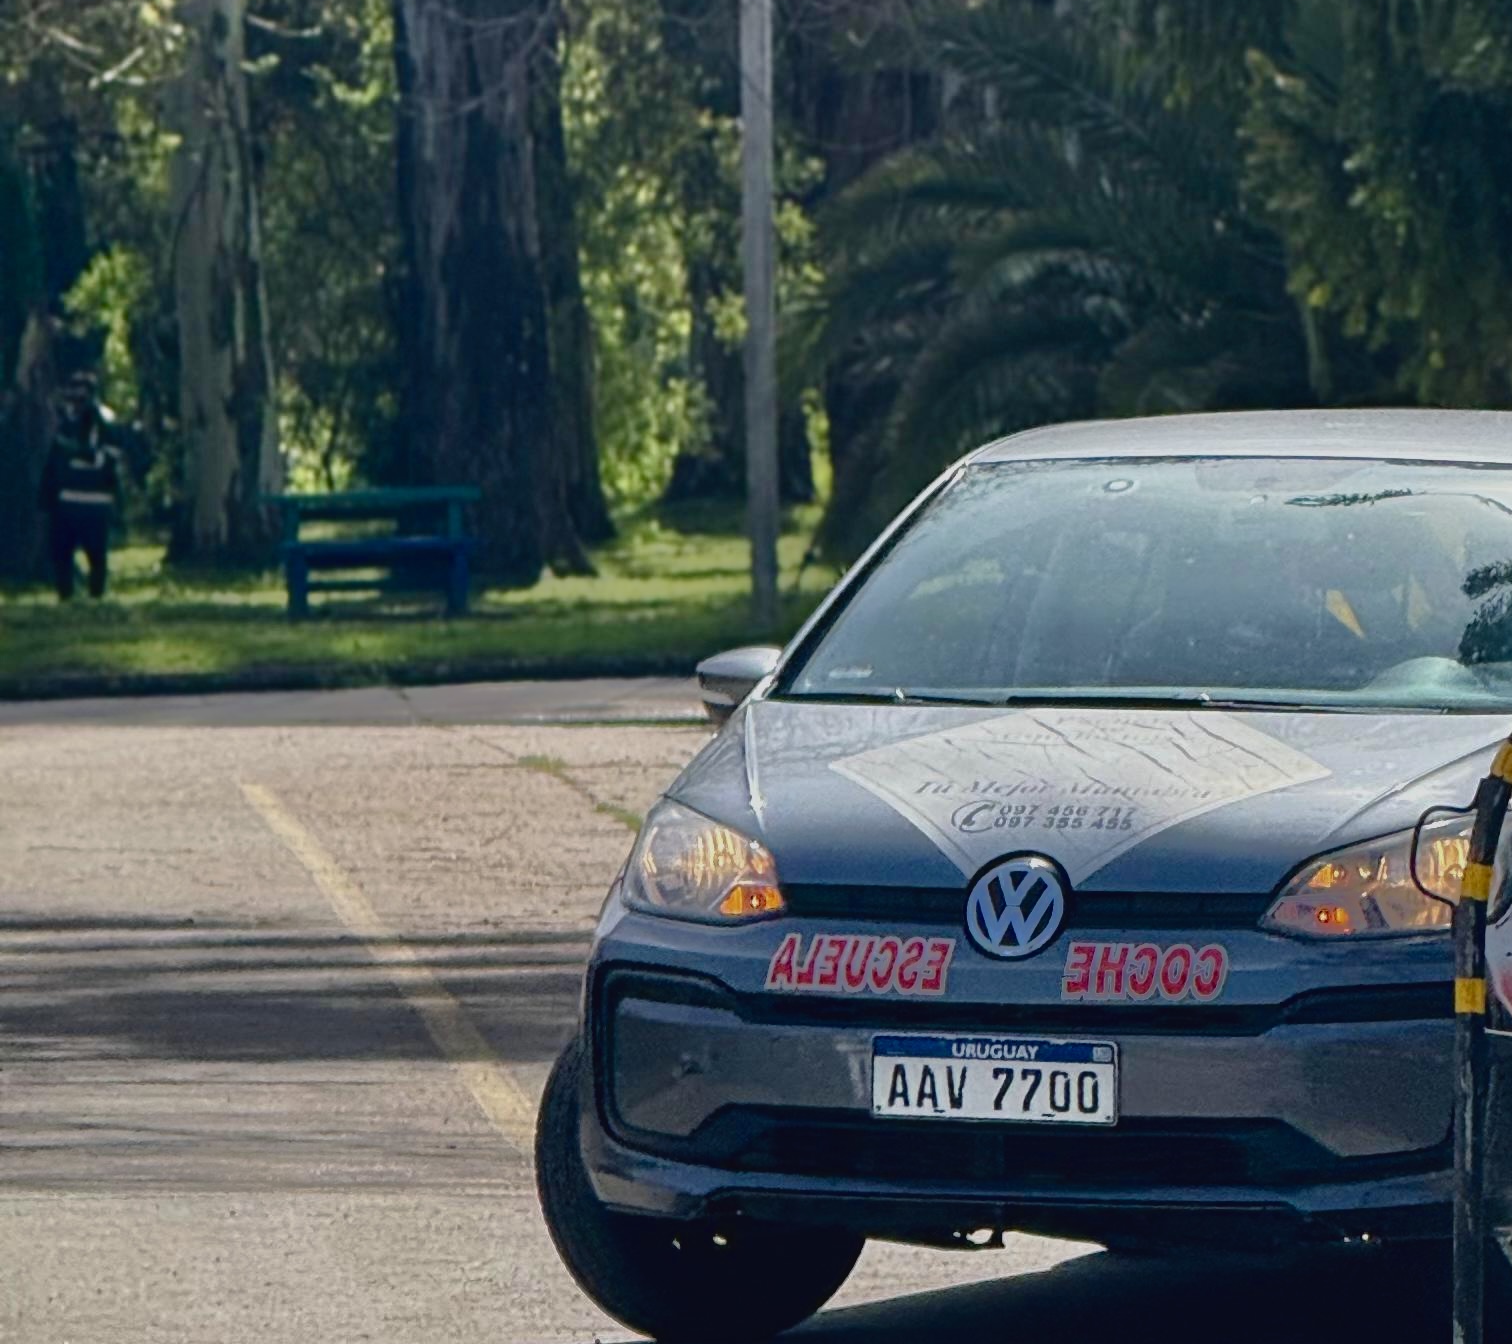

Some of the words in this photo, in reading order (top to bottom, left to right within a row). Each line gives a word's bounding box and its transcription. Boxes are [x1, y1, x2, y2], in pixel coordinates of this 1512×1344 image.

[1000, 804, 1039, 816] 097
[993, 816, 1034, 828] 097
[951, 1042, 1039, 1060] URUGUAY
[888, 1063, 967, 1109] AAV
[992, 1067, 1100, 1114] 7700
